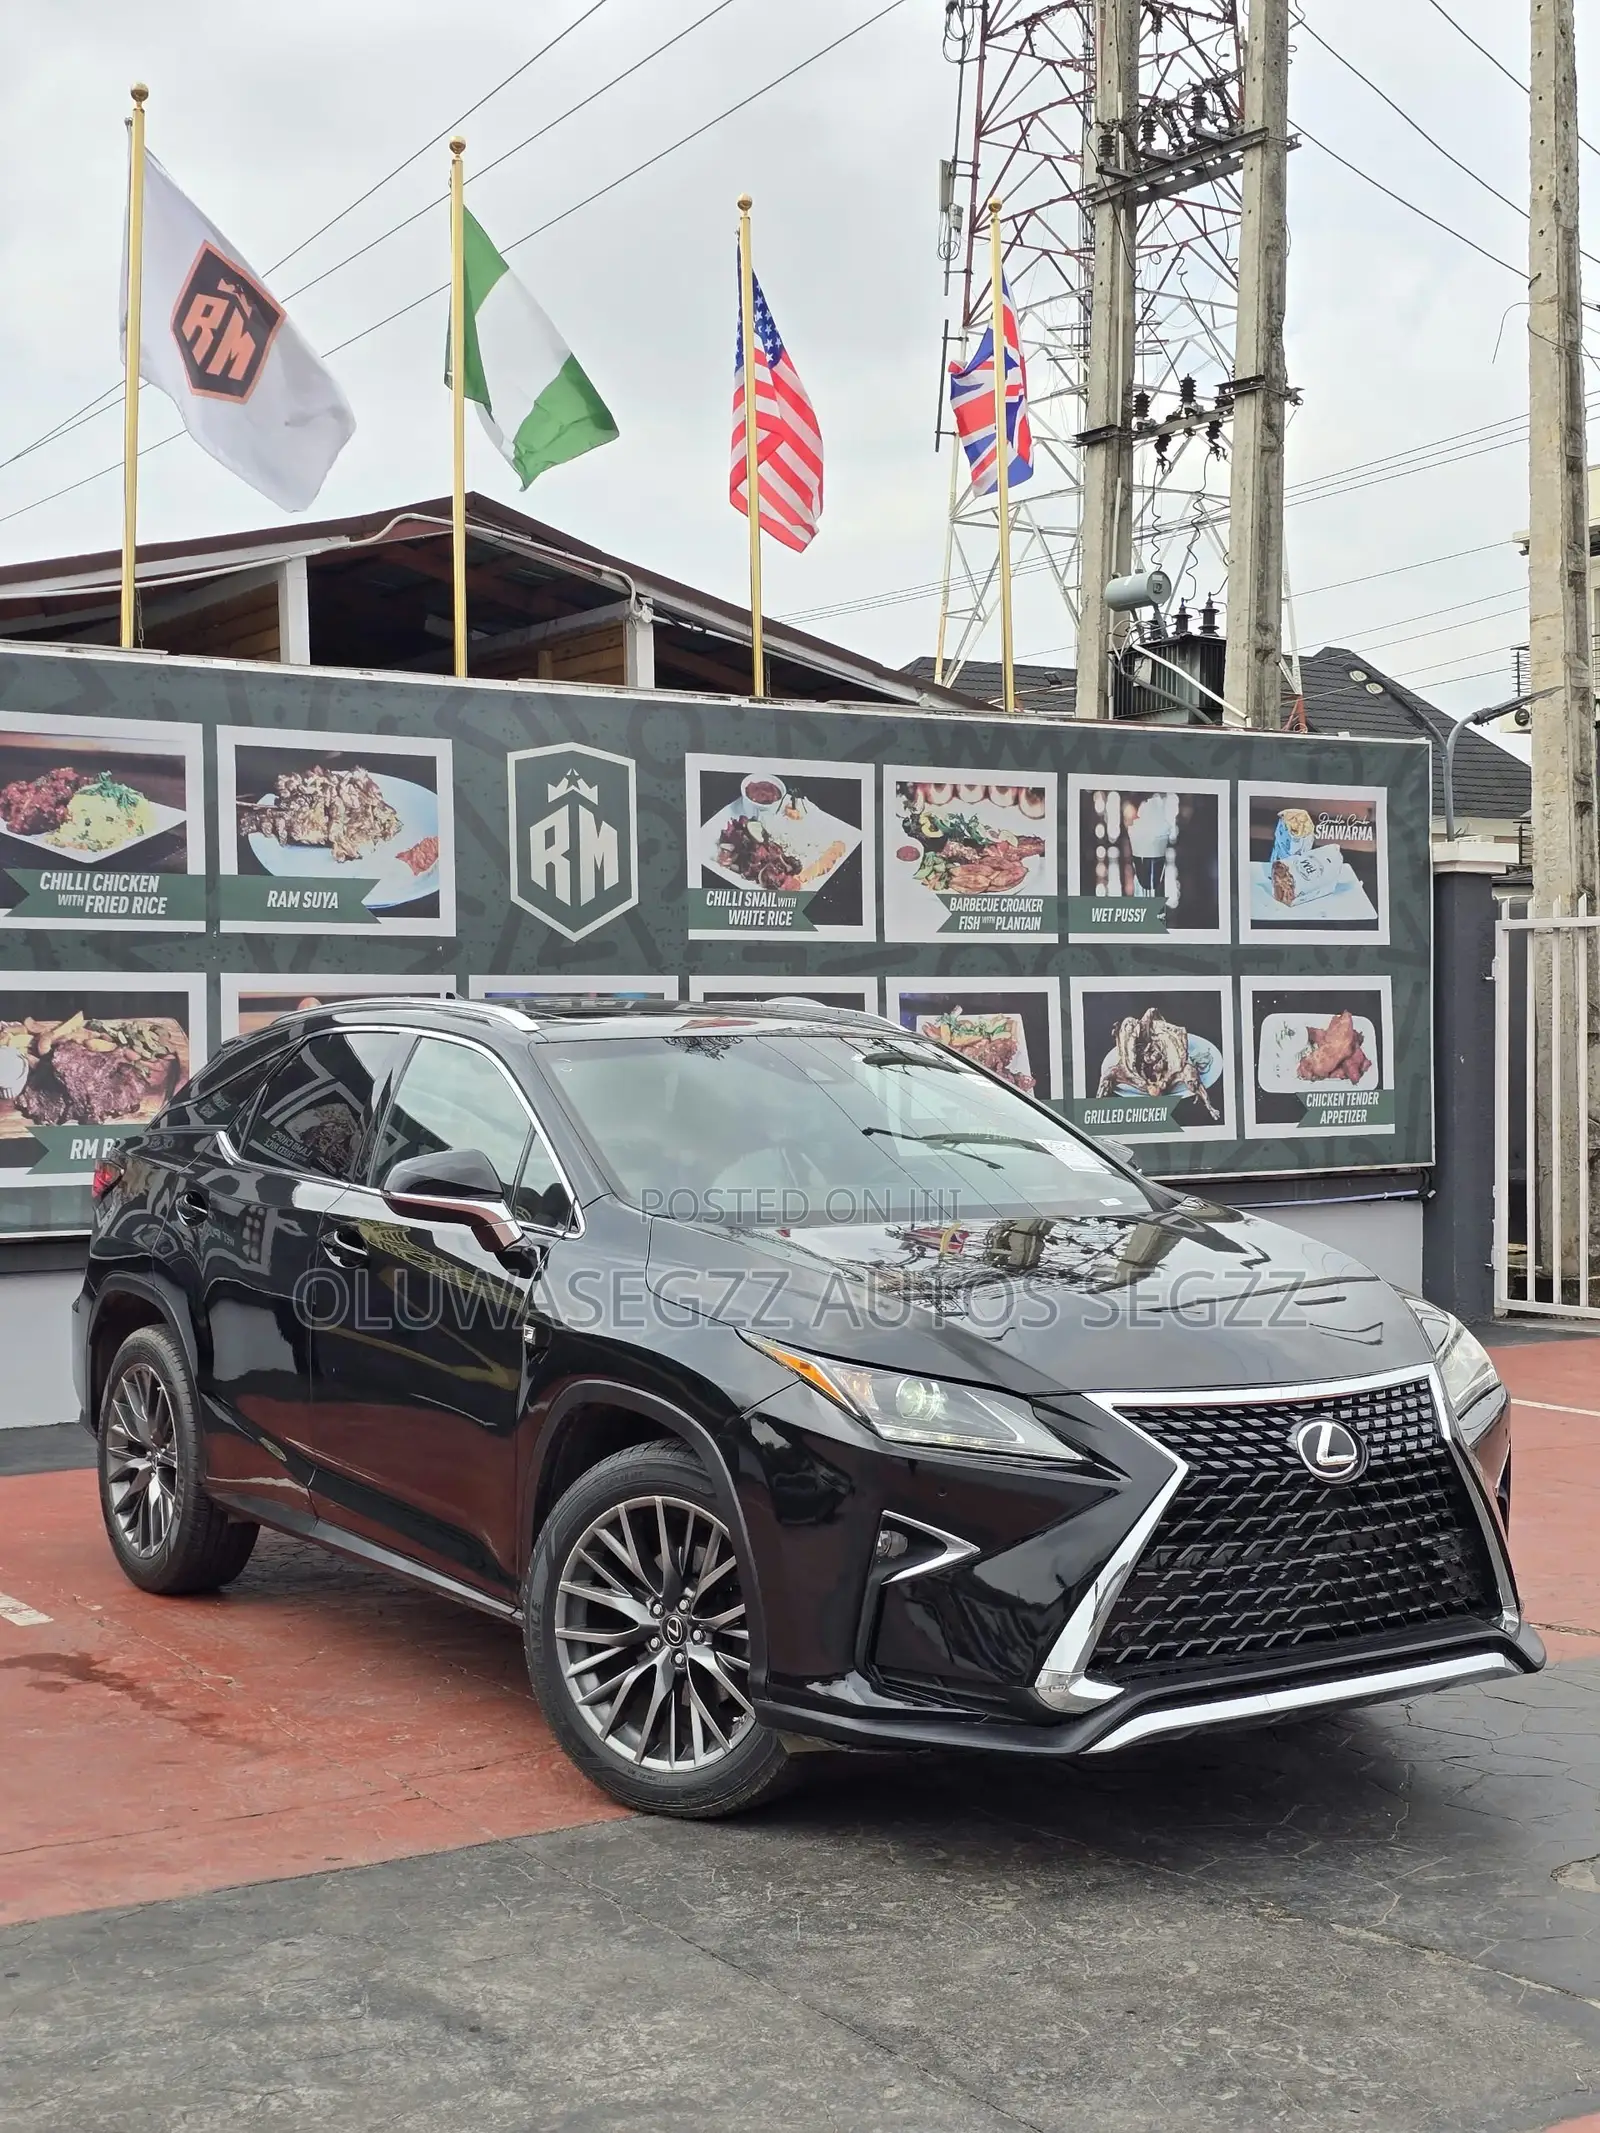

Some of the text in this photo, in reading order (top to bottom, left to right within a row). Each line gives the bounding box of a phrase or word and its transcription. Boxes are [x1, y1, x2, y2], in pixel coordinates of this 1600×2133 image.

[181, 293, 256, 381] RM
[1315, 824, 1373, 841] SHAWARMA
[529, 804, 619, 907] RM
[39, 872, 160, 893] CHILLI CHICKEN
[57, 894, 168, 915] WITH FRIED RICE
[266, 890, 339, 909] RAM SUYA
[706, 890, 797, 908] CHILLI SNAIL WITH
[949, 897, 1044, 913] BARBECUE CROAKER
[728, 909, 794, 926] WHITE RICE
[958, 915, 981, 930] FISH
[995, 916, 1042, 931] PLANTAIN
[1091, 907, 1147, 923] WET PUSSY
[1306, 1091, 1380, 1107] CHICKEN TENDER
[1084, 1107, 1168, 1125] GRILLED CHICKEN
[1319, 1109, 1368, 1125] APPETIZER
[70, 1138, 100, 1160] RM
